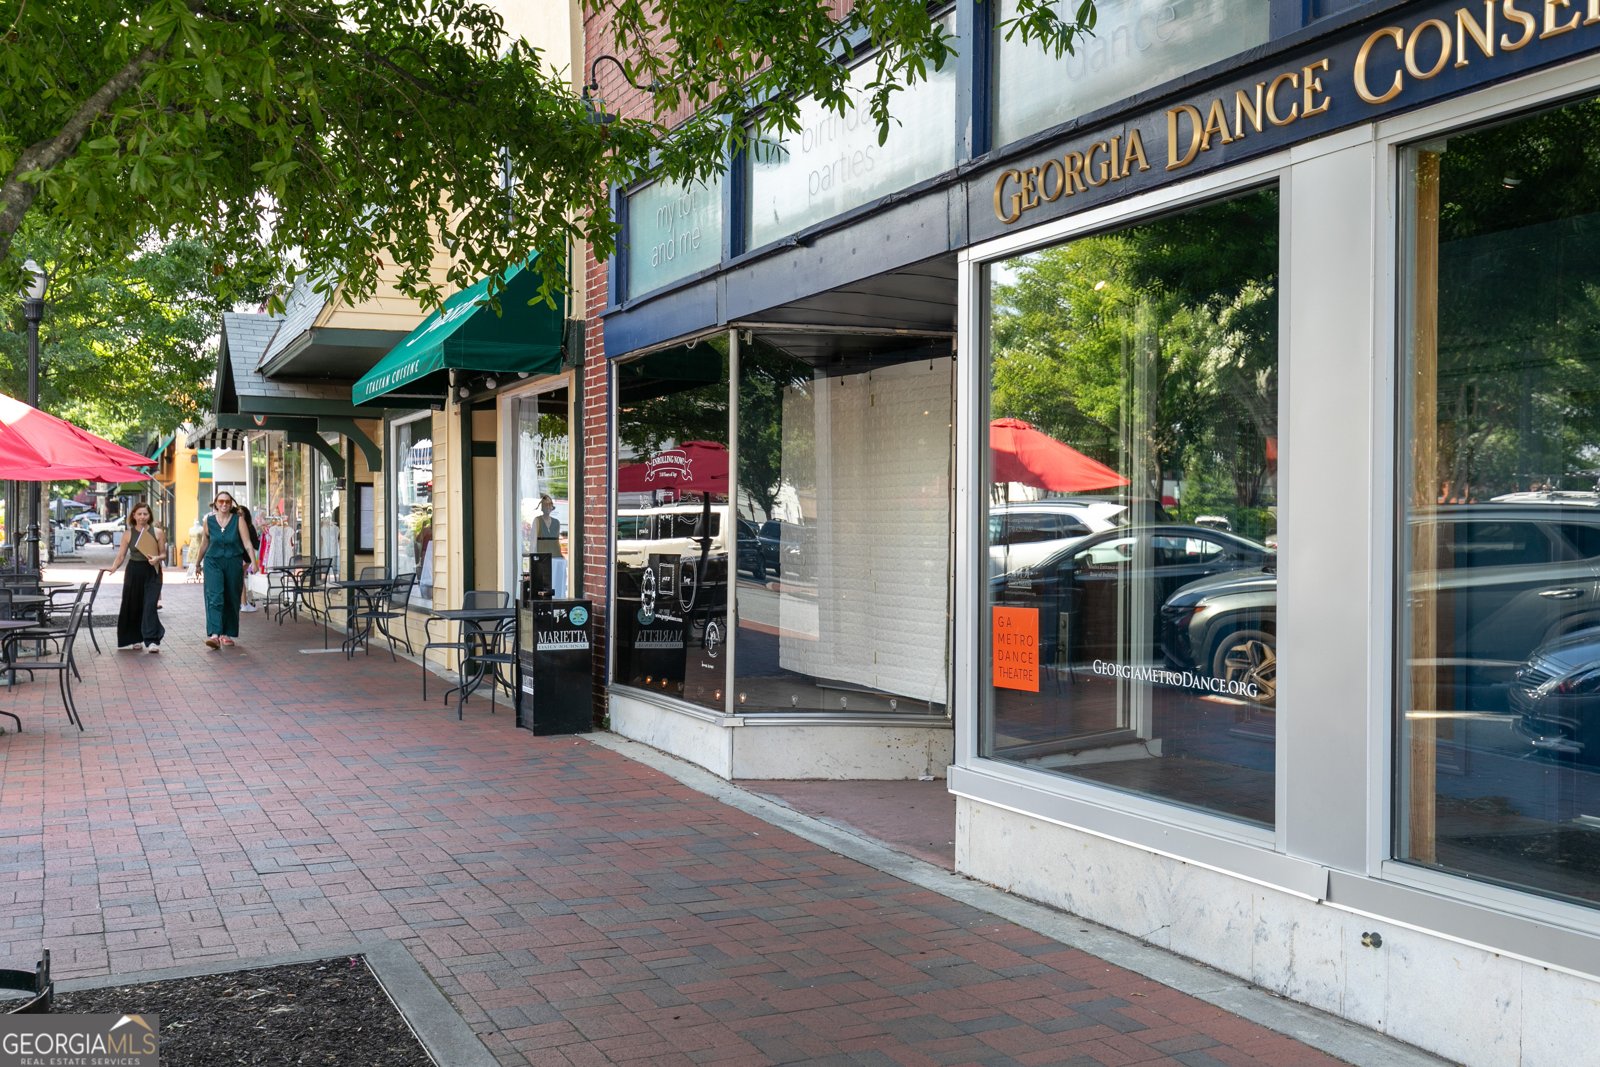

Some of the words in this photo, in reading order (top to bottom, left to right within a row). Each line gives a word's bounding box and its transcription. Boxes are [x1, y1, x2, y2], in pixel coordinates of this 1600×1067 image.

[802, 90, 883, 154] birthda
[993, 128, 1150, 224] GEORGIA
[1165, 57, 1332, 171] DANCE
[1353, 0, 1600, 105] CONSE
[808, 144, 875, 208] parties
[656, 201, 675, 232] my
[678, 187, 697, 218] tot
[651, 226, 676, 267] and
[680, 226, 701, 255] me
[365, 373, 391, 395] ITALIAN
[391, 359, 421, 383] CUISINE
[538, 630, 588, 644] MARIETTA
[997, 615, 1012, 628] GA
[997, 633, 1034, 647] METRO
[997, 649, 1034, 665] DANCE
[998, 666, 1034, 682] THEATRE
